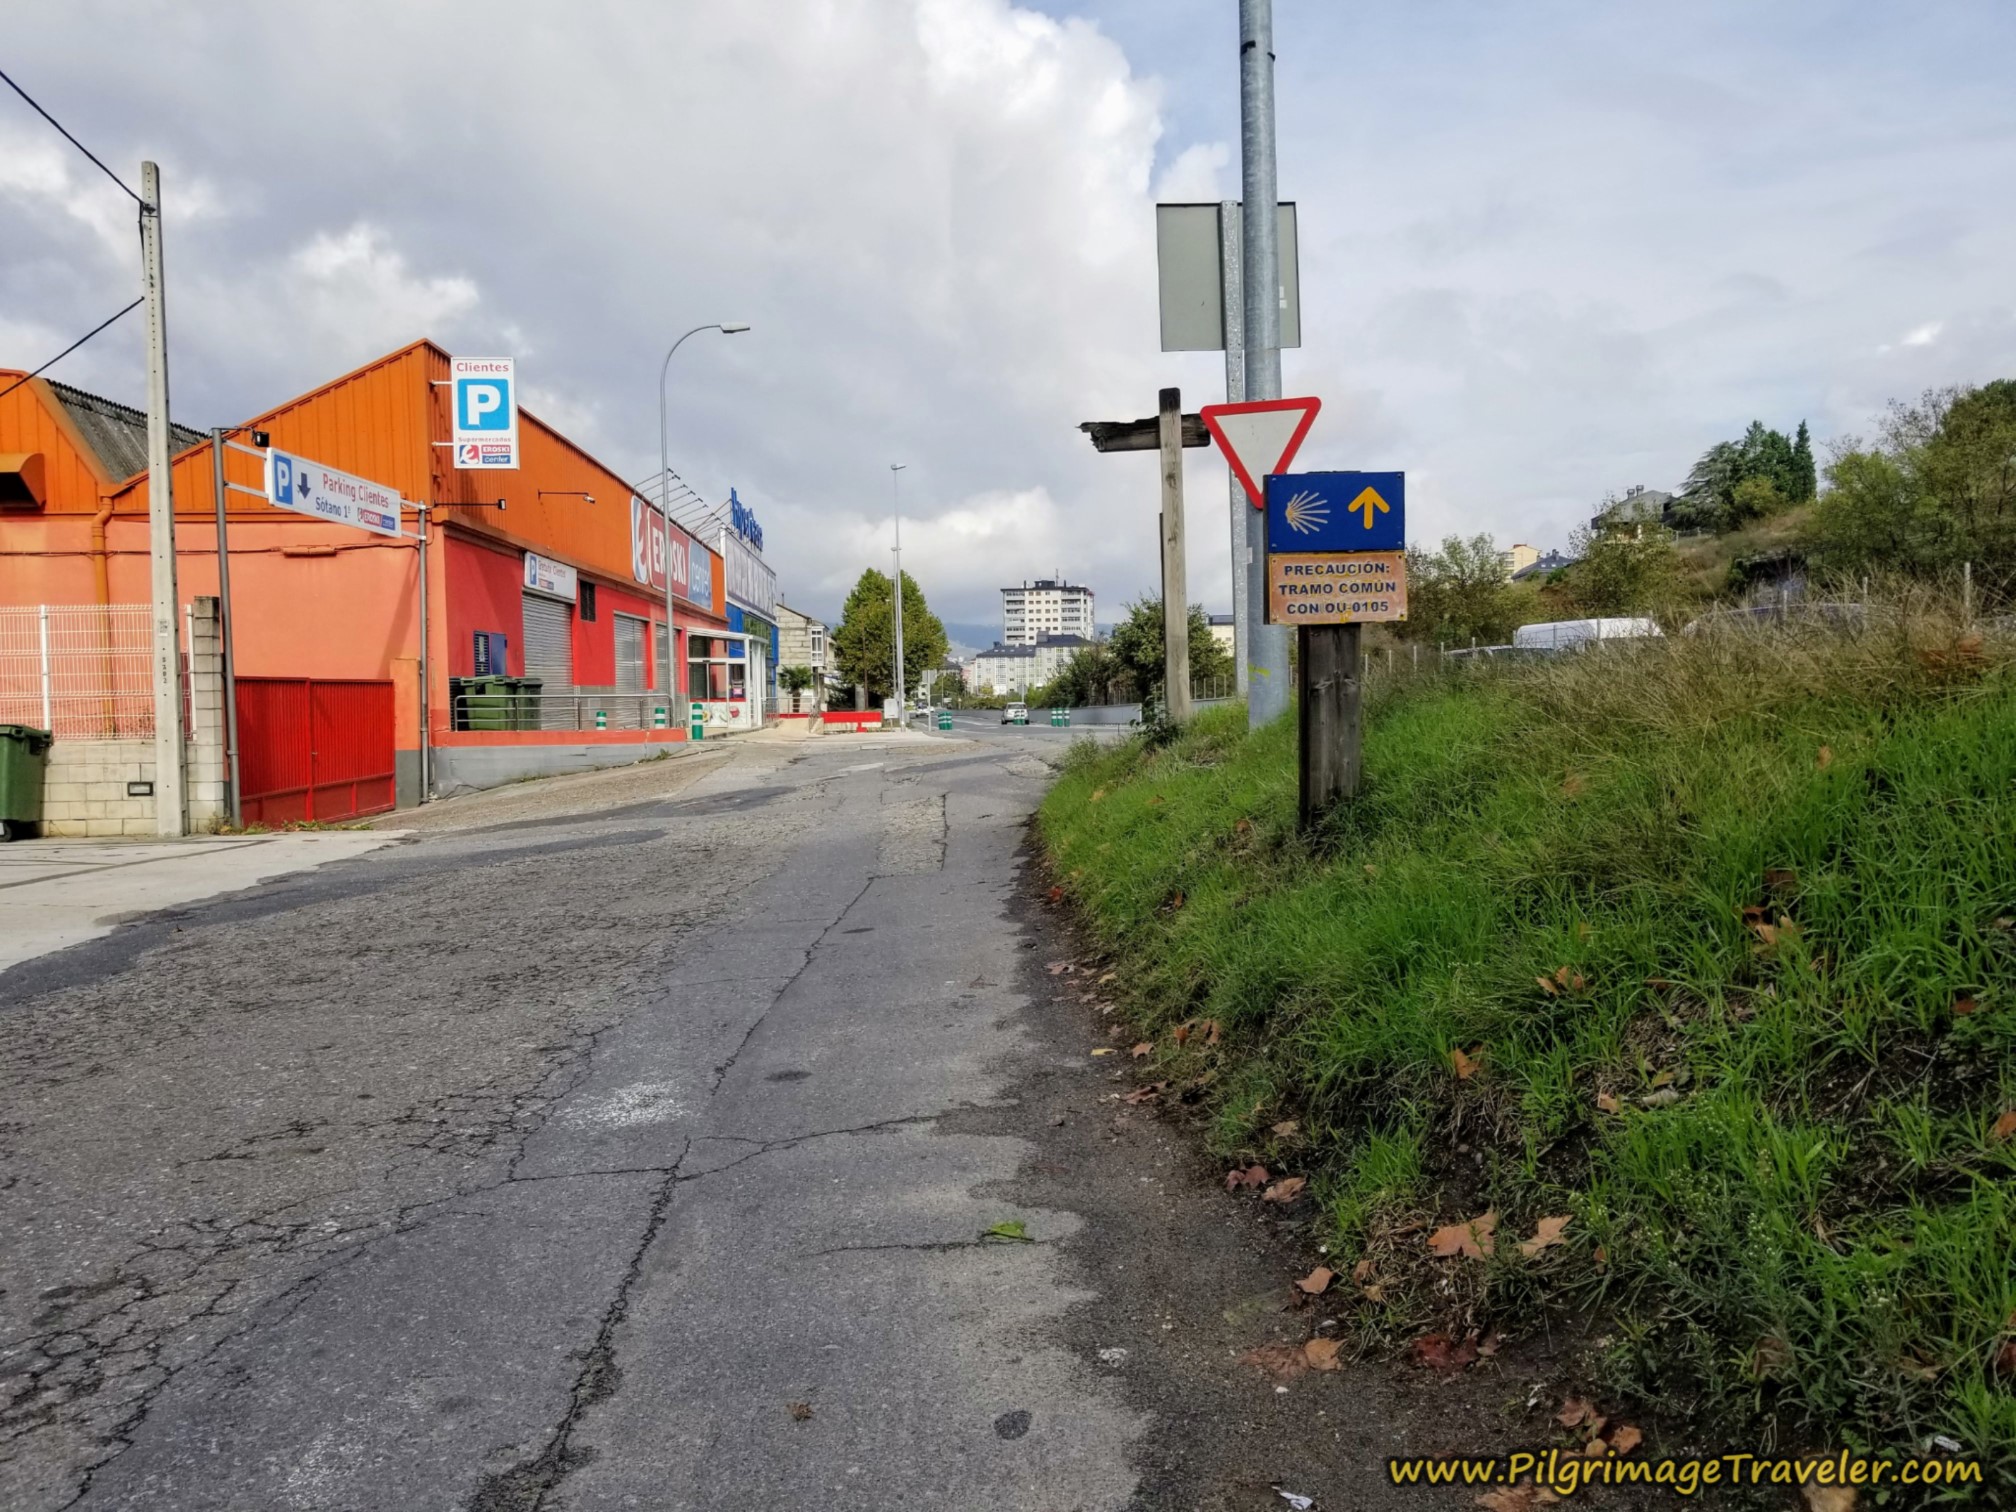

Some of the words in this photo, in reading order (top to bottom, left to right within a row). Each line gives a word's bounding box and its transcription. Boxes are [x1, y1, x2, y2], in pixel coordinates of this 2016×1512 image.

[456, 362, 509, 373] Clientes
[466, 384, 501, 425] P
[482, 445, 510, 453] EROSKI
[276, 460, 290, 497] P
[322, 473, 356, 502] Parking
[358, 485, 389, 508] Clientes
[315, 496, 342, 517] Sótano
[1284, 561, 1390, 575] PRECAUCIÓN:
[1278, 583, 1334, 595] TRAMO
[1339, 580, 1396, 594] COMÚN
[1286, 603, 1319, 615] CON
